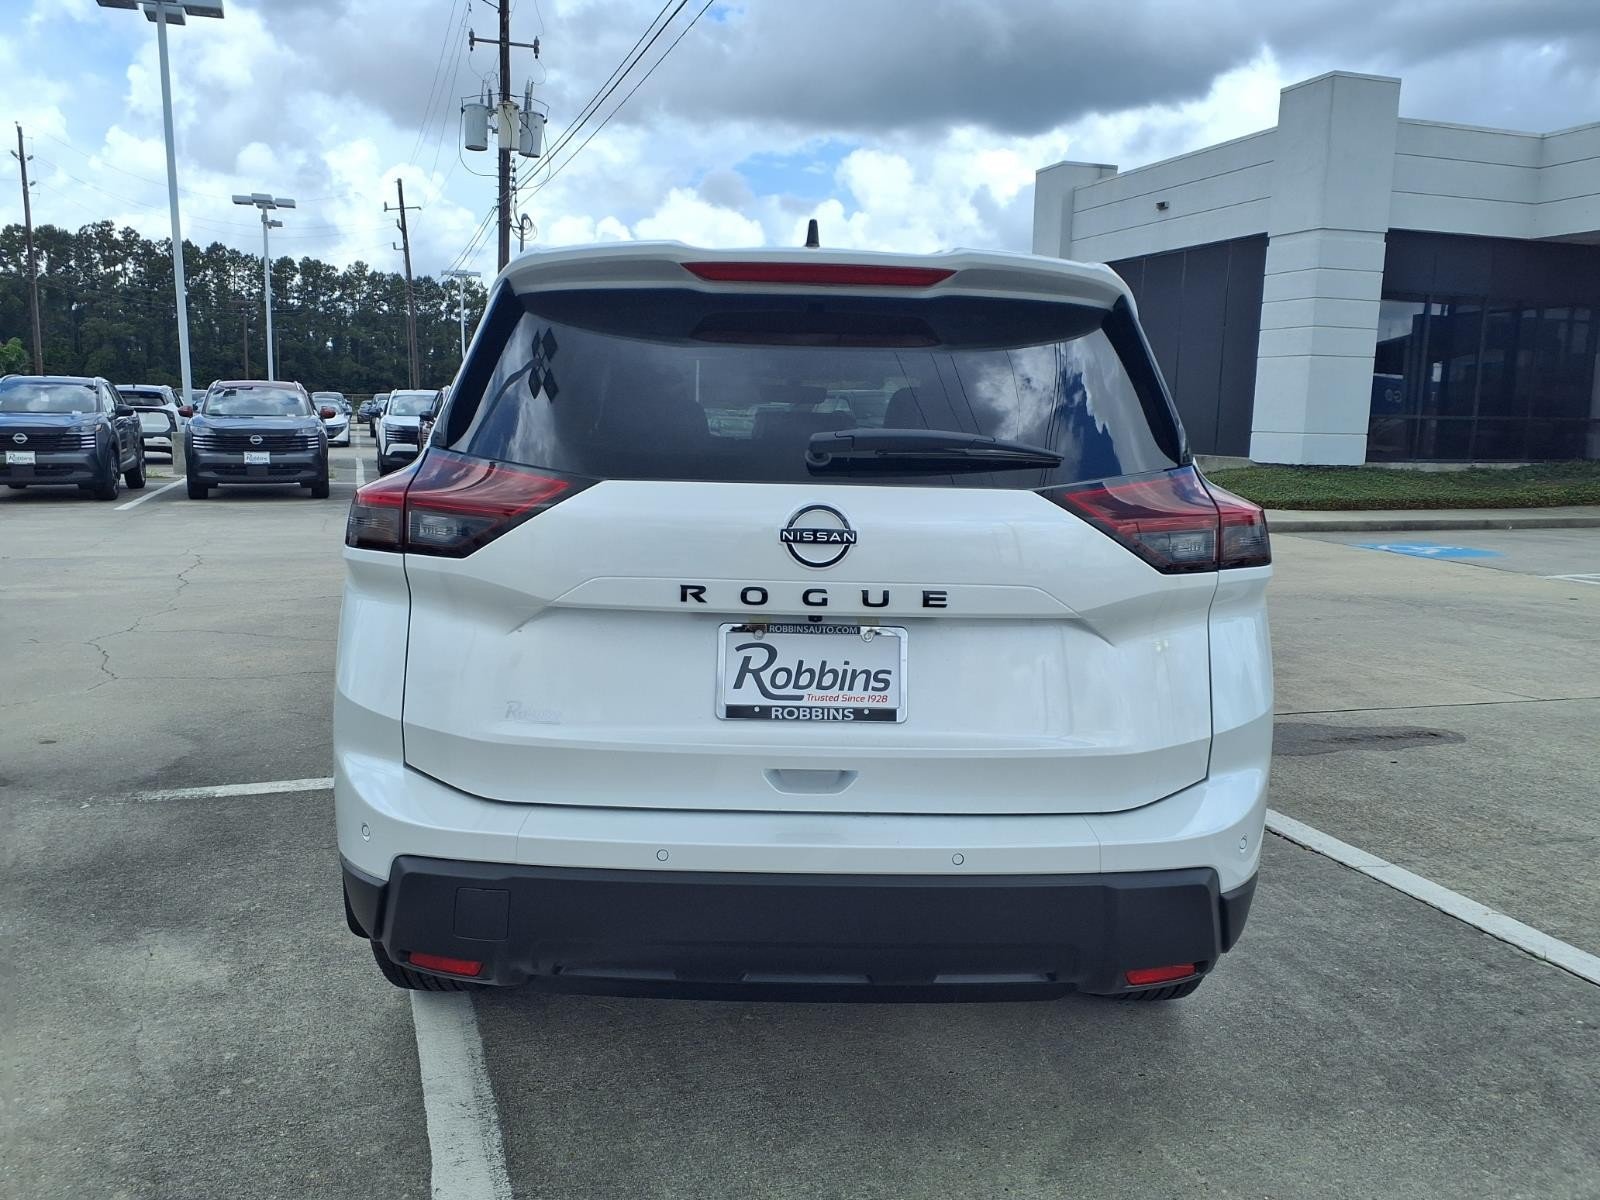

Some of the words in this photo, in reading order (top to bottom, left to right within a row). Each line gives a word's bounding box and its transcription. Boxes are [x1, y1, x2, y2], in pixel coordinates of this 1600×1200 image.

[781, 530, 856, 543] NISSAN
[679, 584, 948, 609] ROGUE
[768, 625, 858, 635] ROBBINSAUTO.COM
[732, 642, 893, 701] Robbins
[806, 693, 839, 702] Trusted
[841, 694, 865, 703] Since
[867, 694, 889, 703] 1928
[771, 706, 855, 721] ROBBINS
